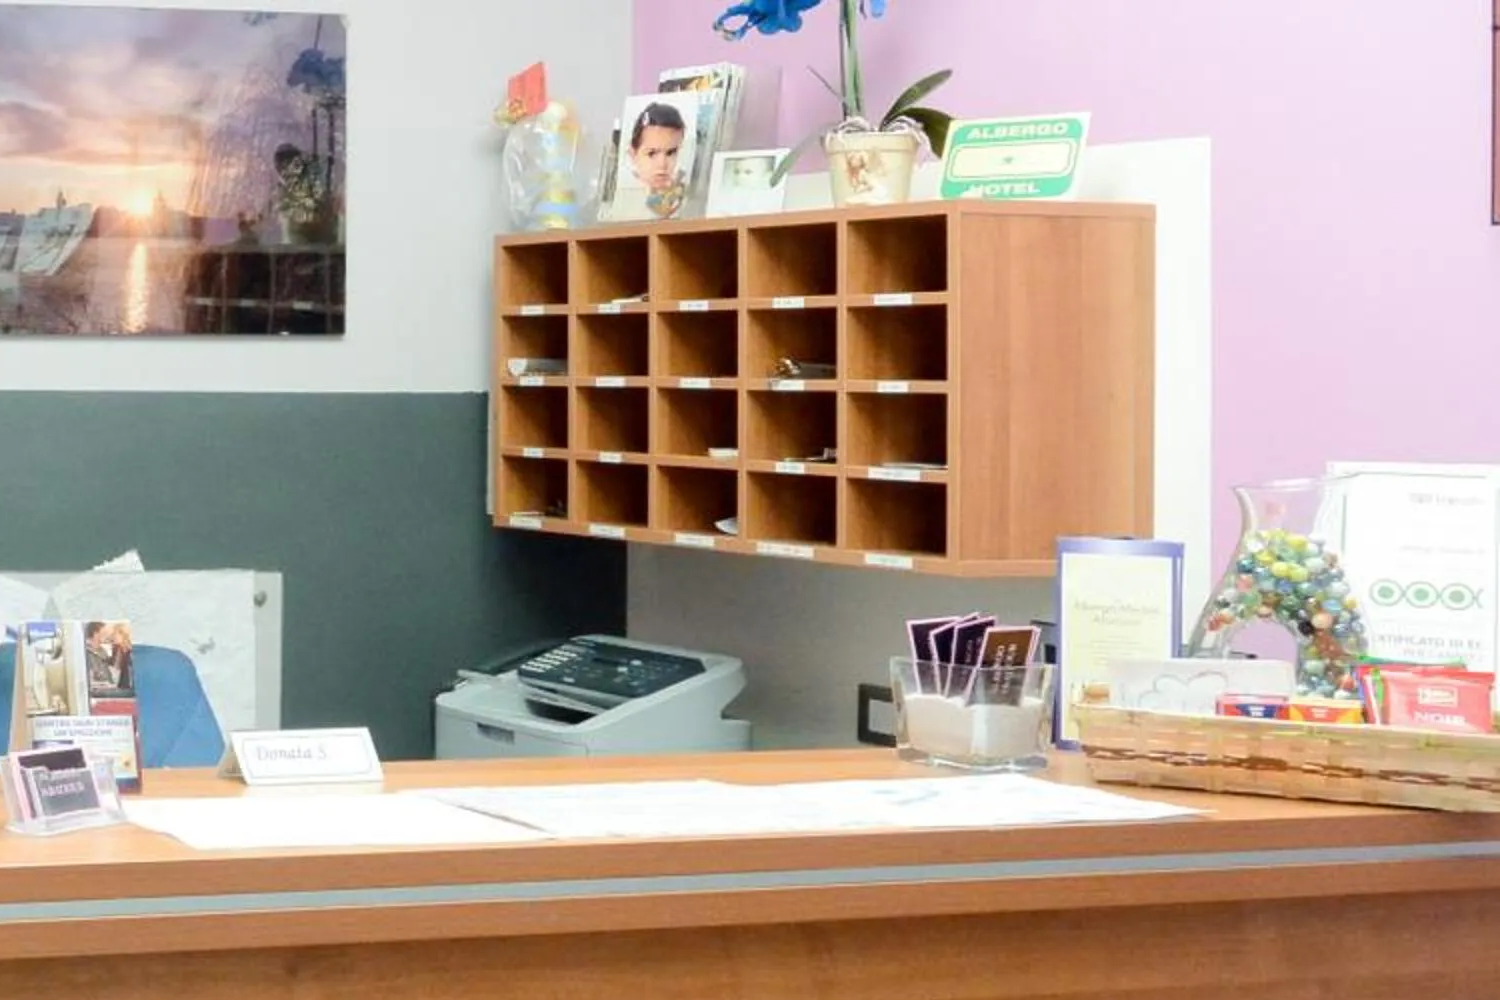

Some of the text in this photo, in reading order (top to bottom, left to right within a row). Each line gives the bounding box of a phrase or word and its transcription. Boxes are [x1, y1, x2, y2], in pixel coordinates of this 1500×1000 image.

[967, 122, 1069, 140] ALBERGO
[962, 180, 1041, 198] HOTEL
[256, 742, 313, 761] Donata
